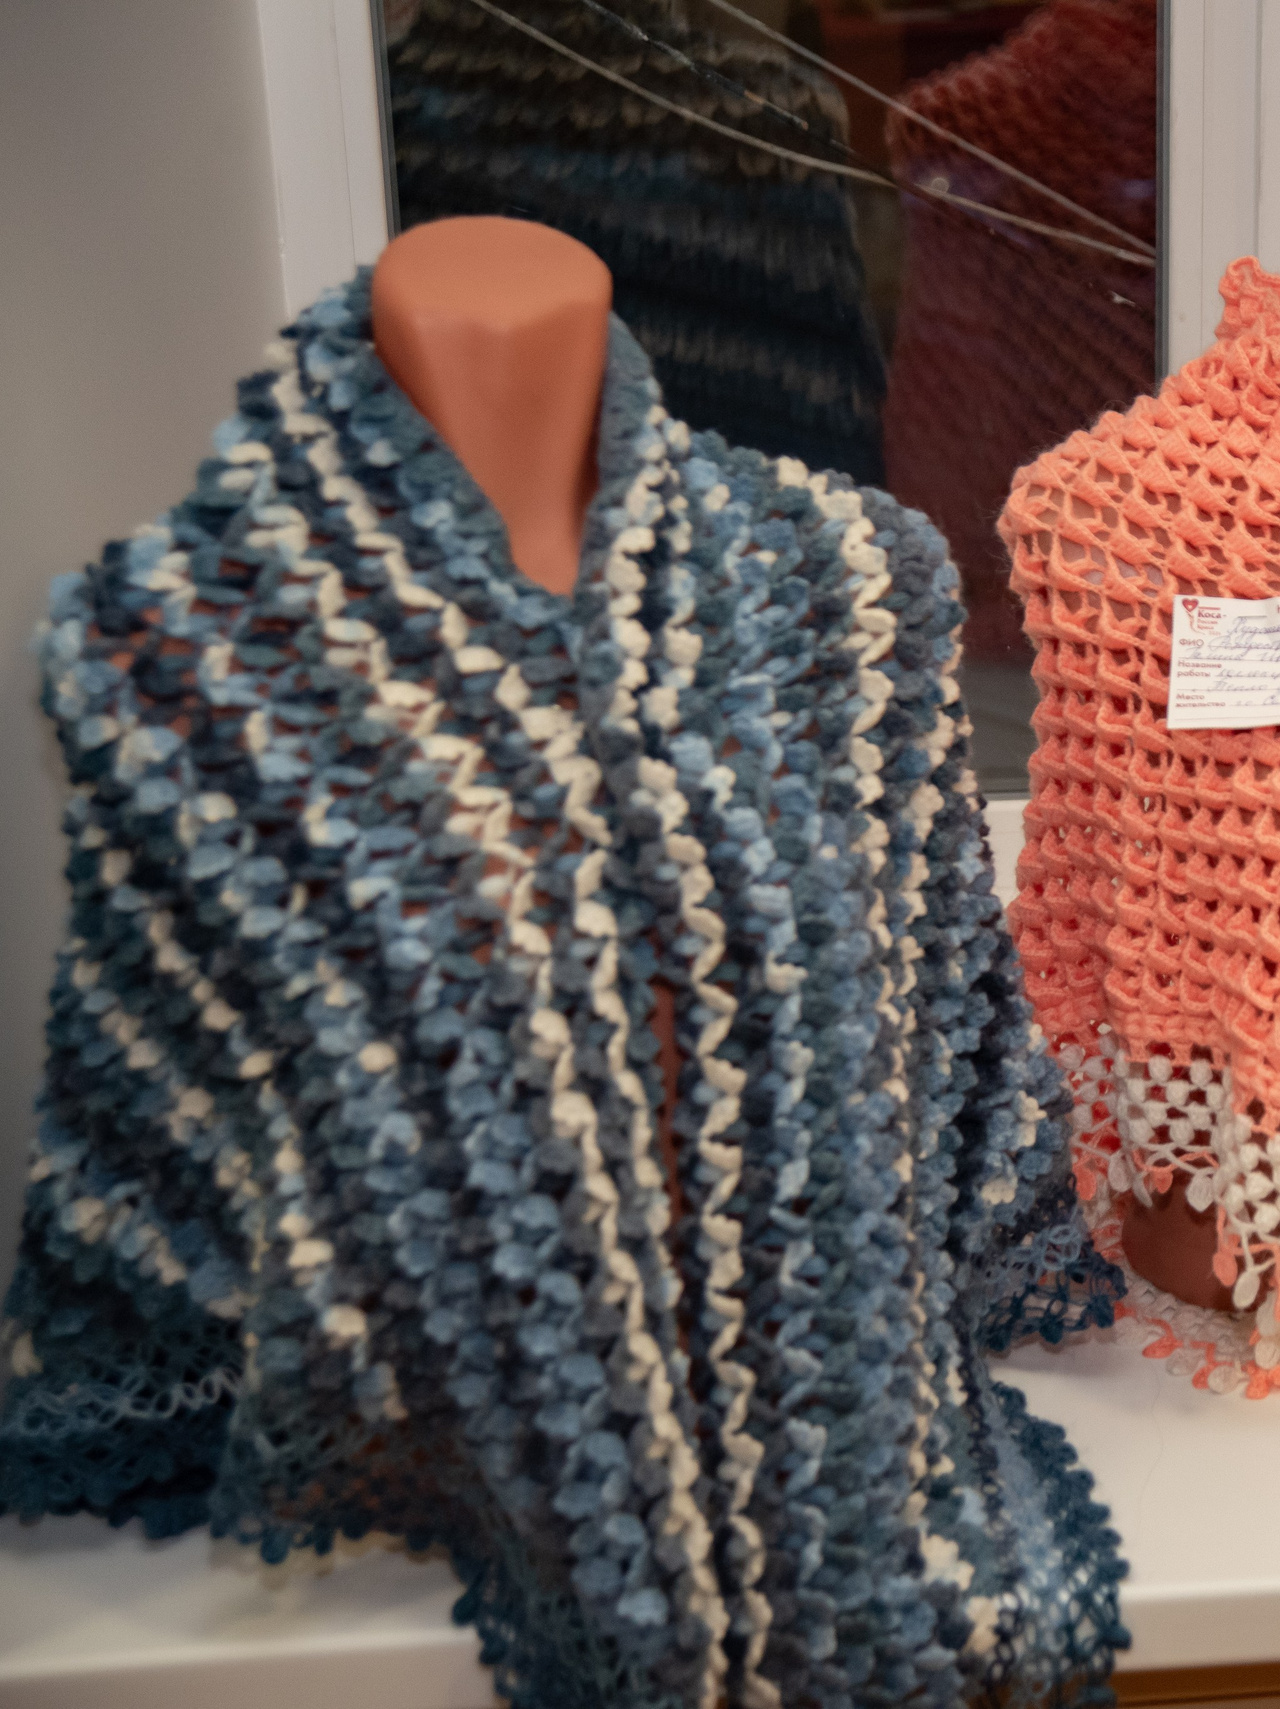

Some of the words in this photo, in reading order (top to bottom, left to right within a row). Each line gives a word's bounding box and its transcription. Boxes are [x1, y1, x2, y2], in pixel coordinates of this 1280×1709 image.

[1179, 638, 1204, 647] ФИО
[1177, 660, 1222, 668] Название
[1177, 669, 1210, 678] работы
